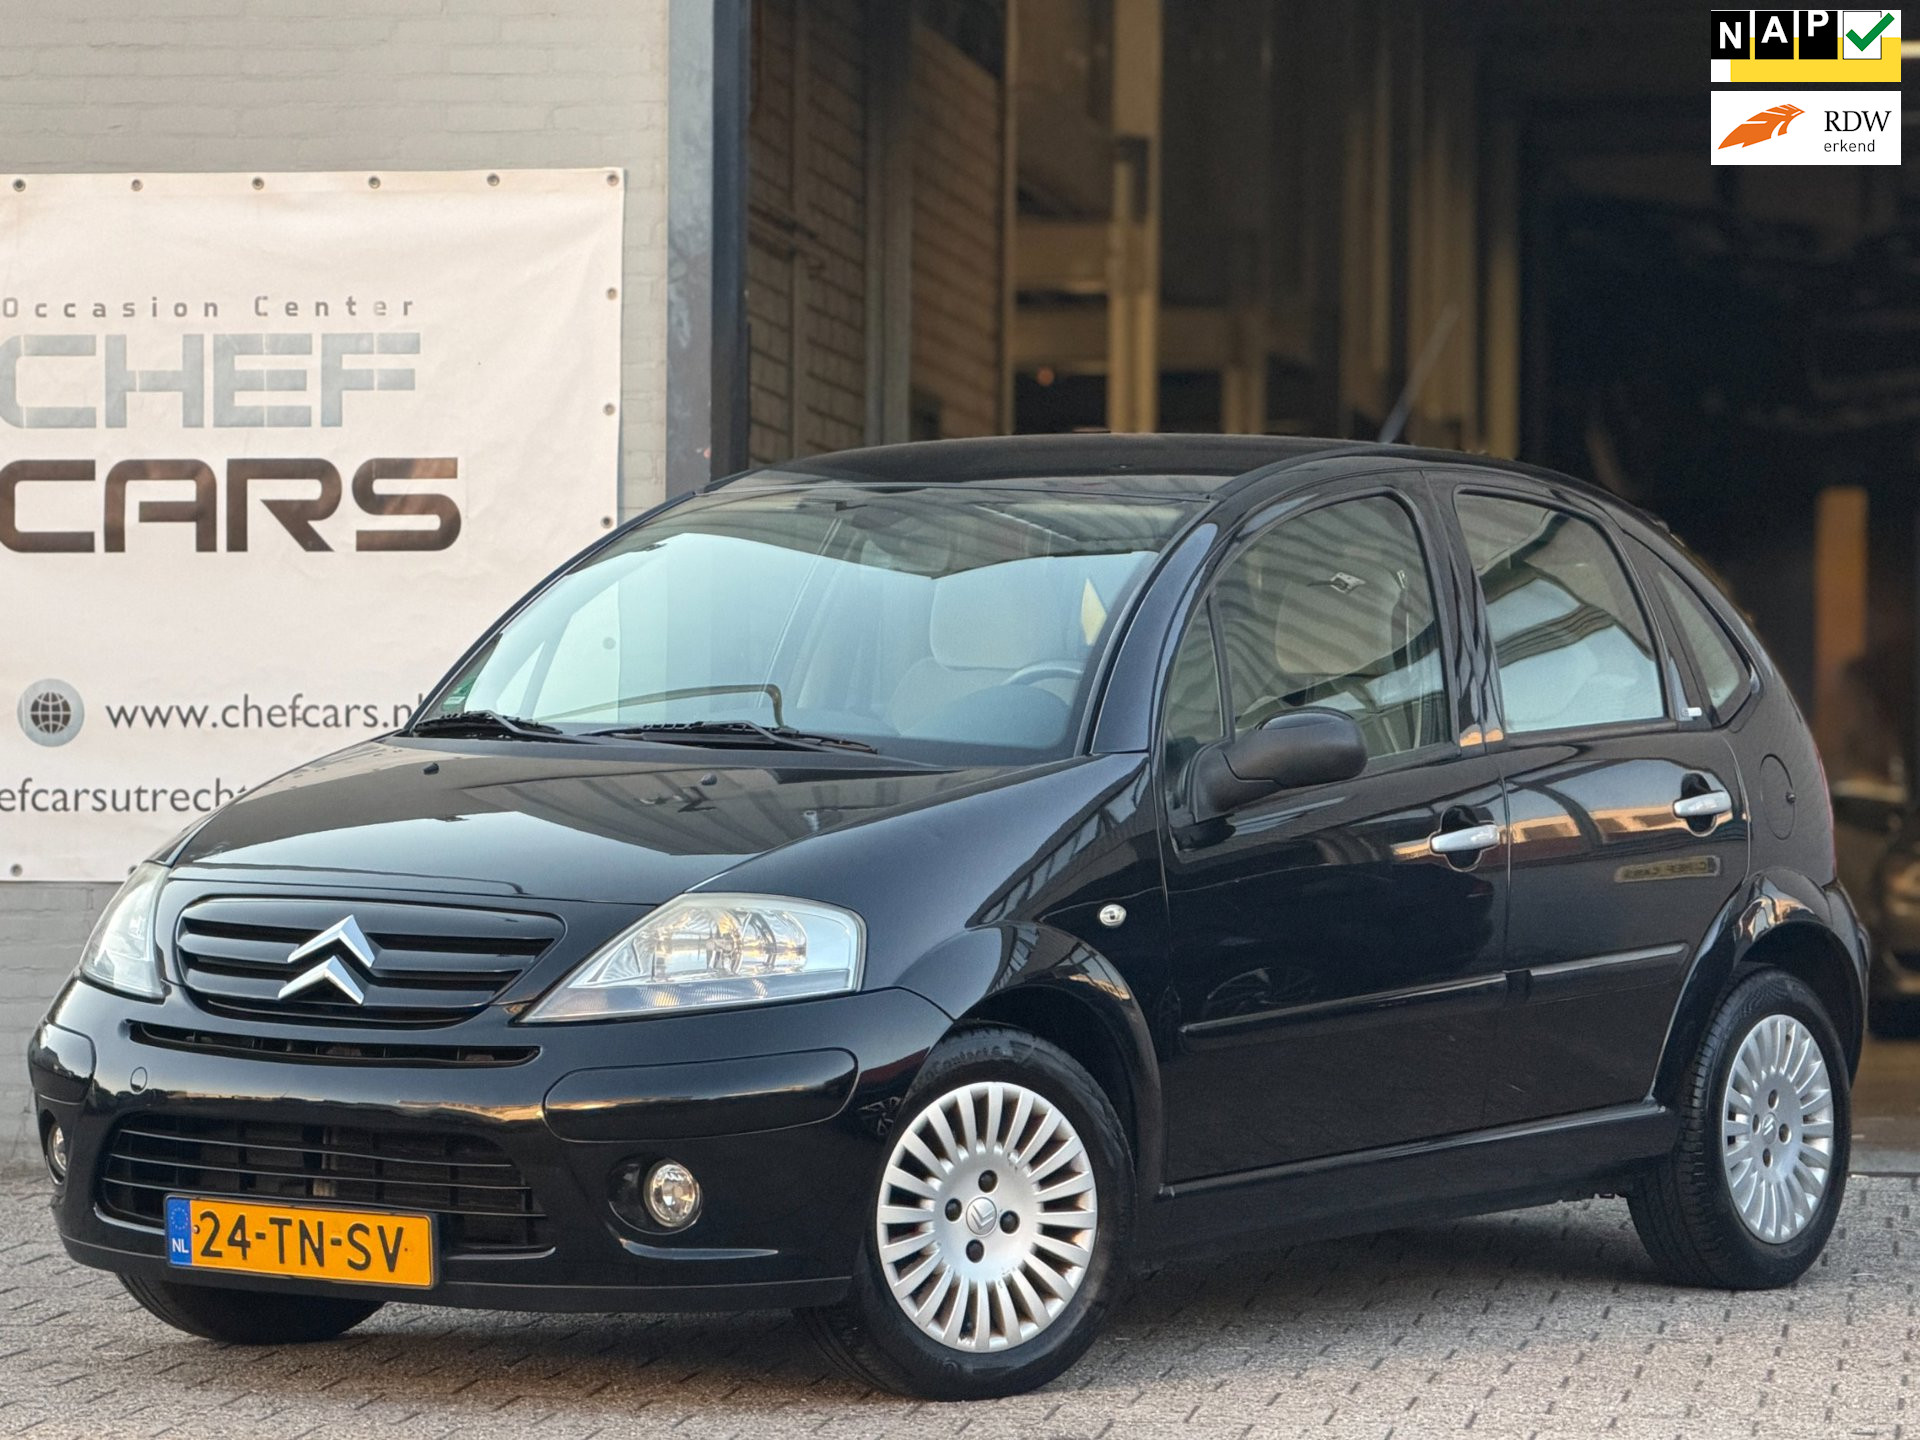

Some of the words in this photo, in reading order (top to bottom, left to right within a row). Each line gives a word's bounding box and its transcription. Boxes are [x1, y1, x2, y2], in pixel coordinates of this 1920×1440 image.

[2, 297, 219, 319] Occasion
[254, 295, 414, 317] Center
[0, 332, 421, 429] CHEF
[0, 457, 462, 553] CARS
[172, 1238, 189, 1254] NL
[200, 1210, 404, 1273] 24-TN-SV
